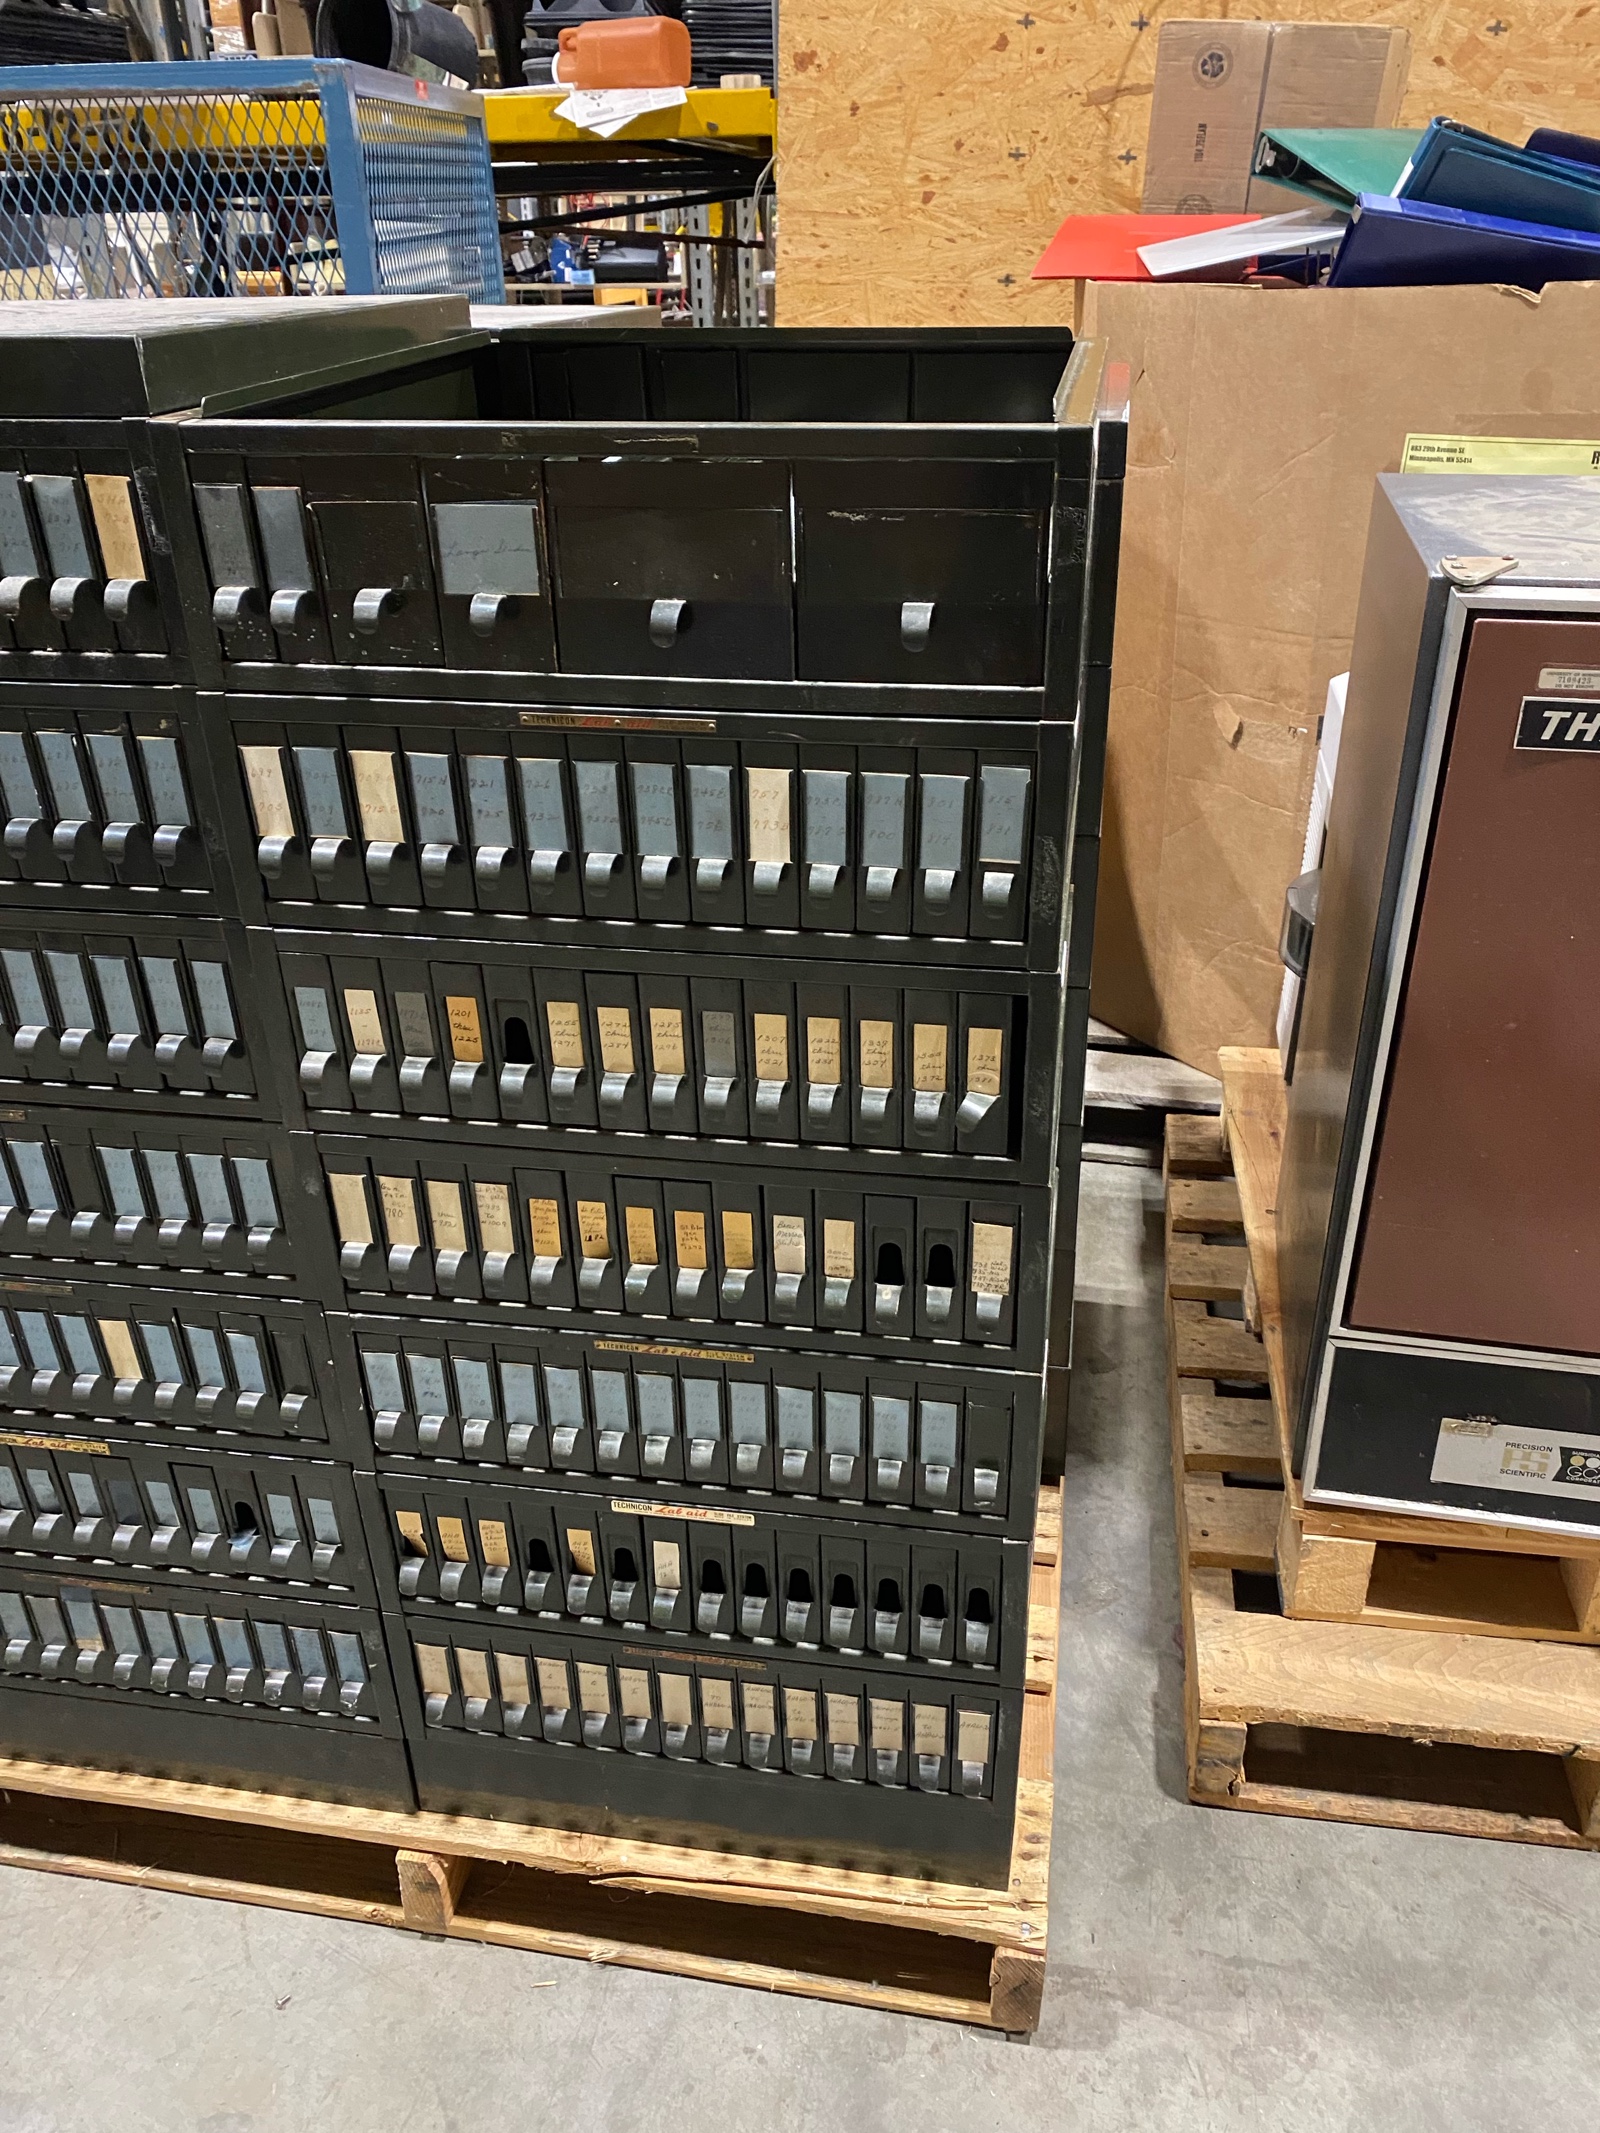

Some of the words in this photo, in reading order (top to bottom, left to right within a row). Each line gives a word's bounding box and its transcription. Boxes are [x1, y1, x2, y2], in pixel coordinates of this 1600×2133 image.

[1409, 455, 1444, 463] Minneapolis,
[531, 715, 575, 726] TECHNICON
[450, 1009, 471, 1018] 1201
[454, 1035, 479, 1043] 1225
[386, 1207, 404, 1218] 780
[602, 1343, 639, 1351] TECHNICON
[1505, 1441, 1554, 1453] PRECISION
[1500, 1468, 1547, 1479] SCIENTIFIC
[613, 1501, 653, 1512] TECHNICON
[655, 1506, 682, 1515] Lab
[686, 1509, 708, 1518] aid
